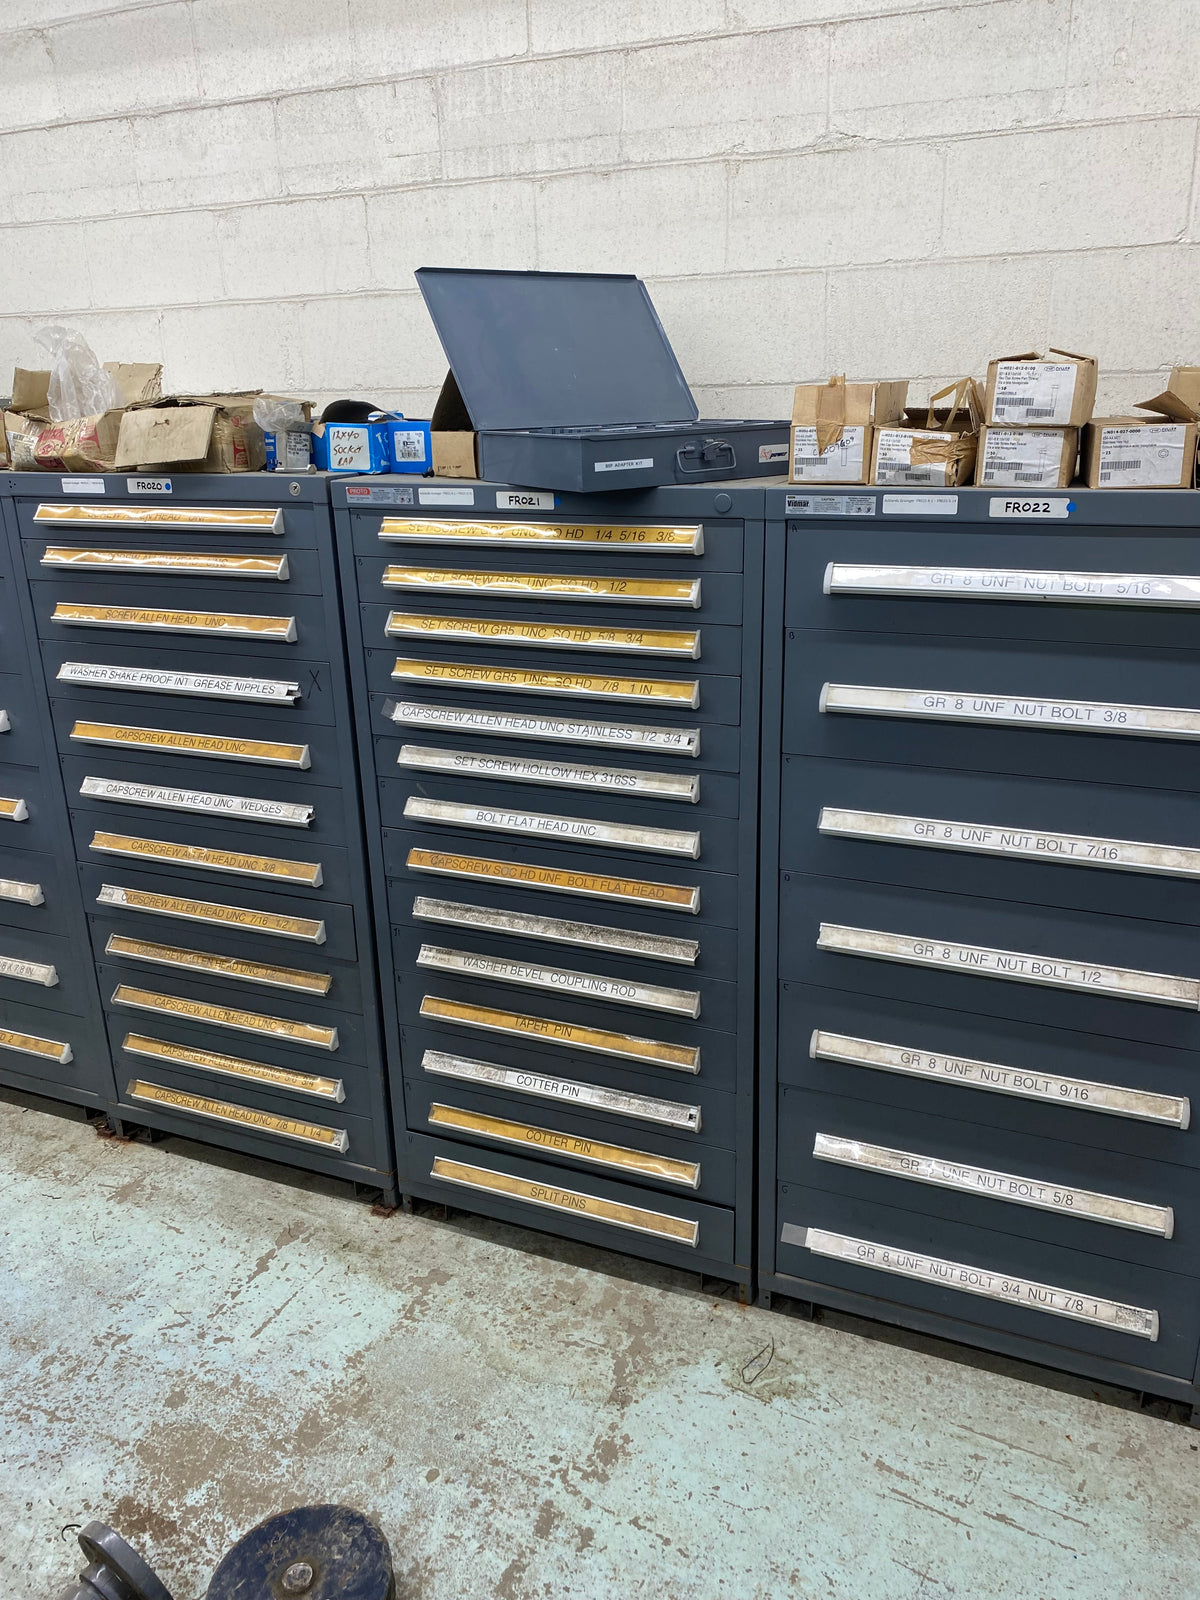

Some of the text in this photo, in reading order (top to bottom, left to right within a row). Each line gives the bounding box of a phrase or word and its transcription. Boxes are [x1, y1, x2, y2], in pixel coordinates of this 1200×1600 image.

[787, 500, 809, 508] Vidmar
[565, 528, 675, 542] HD 1/4 5/16 3/8
[610, 581, 627, 592] 1/2
[930, 573, 1014, 589] GR UNF
[105, 609, 197, 624] SCREW ALLEN HEAD
[421, 619, 643, 645] SET SCREW GR5 UNC HD 3/4
[70, 666, 275, 695] WASHER SHAKE PROOF INT GREASE NIPPLES
[424, 665, 652, 694] SET SCREW GR5 HD 7/8 1 IN
[922, 696, 1127, 723] GR 8 UNF NUT BOLT 3/8
[401, 705, 463, 722] CAPSCREW
[464, 712, 501, 726] ALLEN
[504, 716, 536, 729] HEAD
[539, 720, 564, 732] UNC
[566, 722, 632, 739] STAINLESS
[640, 730, 656, 742] 1/2
[663, 732, 681, 744] 3/4
[115, 730, 246, 753] CAPSCREW ALLEN HEAD UNC
[454, 755, 637, 786] SET SCREW HOLLOW HEX 316SS
[106, 784, 281, 814] CAPSCREW ALLEN HEAD UNC WEDGES
[476, 811, 596, 836] BOLT FLAT HEAD UNC
[913, 822, 1118, 860] GR 8 UNF NUT BOLT 7/16
[131, 841, 275, 873] CAPSCREW HEAD UNC 3/8
[520, 868, 630, 893] HD UNF BOLT FLAT
[121, 892, 267, 925] CAPSCREW ALLEN HEAD UNC 7/16
[462, 955, 636, 998] WASHER BEVEL COUPLING ROD
[913, 943, 1101, 983] GR 8 UNF NUT BOLT 1/2
[514, 1015, 572, 1038] TAPER PIN
[516, 1074, 580, 1097] COTTER PIN
[900, 1052, 1089, 1100] GR 8 UNF NUT BOLT 9/16
[155, 1089, 288, 1130] CAPSCREW ALLEN HEAD UNC 7/8
[526, 1129, 591, 1153] COTTER PIN
[900, 1158, 1074, 1206] GR NUT BOLT 5/8
[530, 1186, 586, 1209] SPLIT PINS
[856, 1245, 1098, 1314] GR 8 UNF NUT BOLT 3/4 NUT 7/8 1
